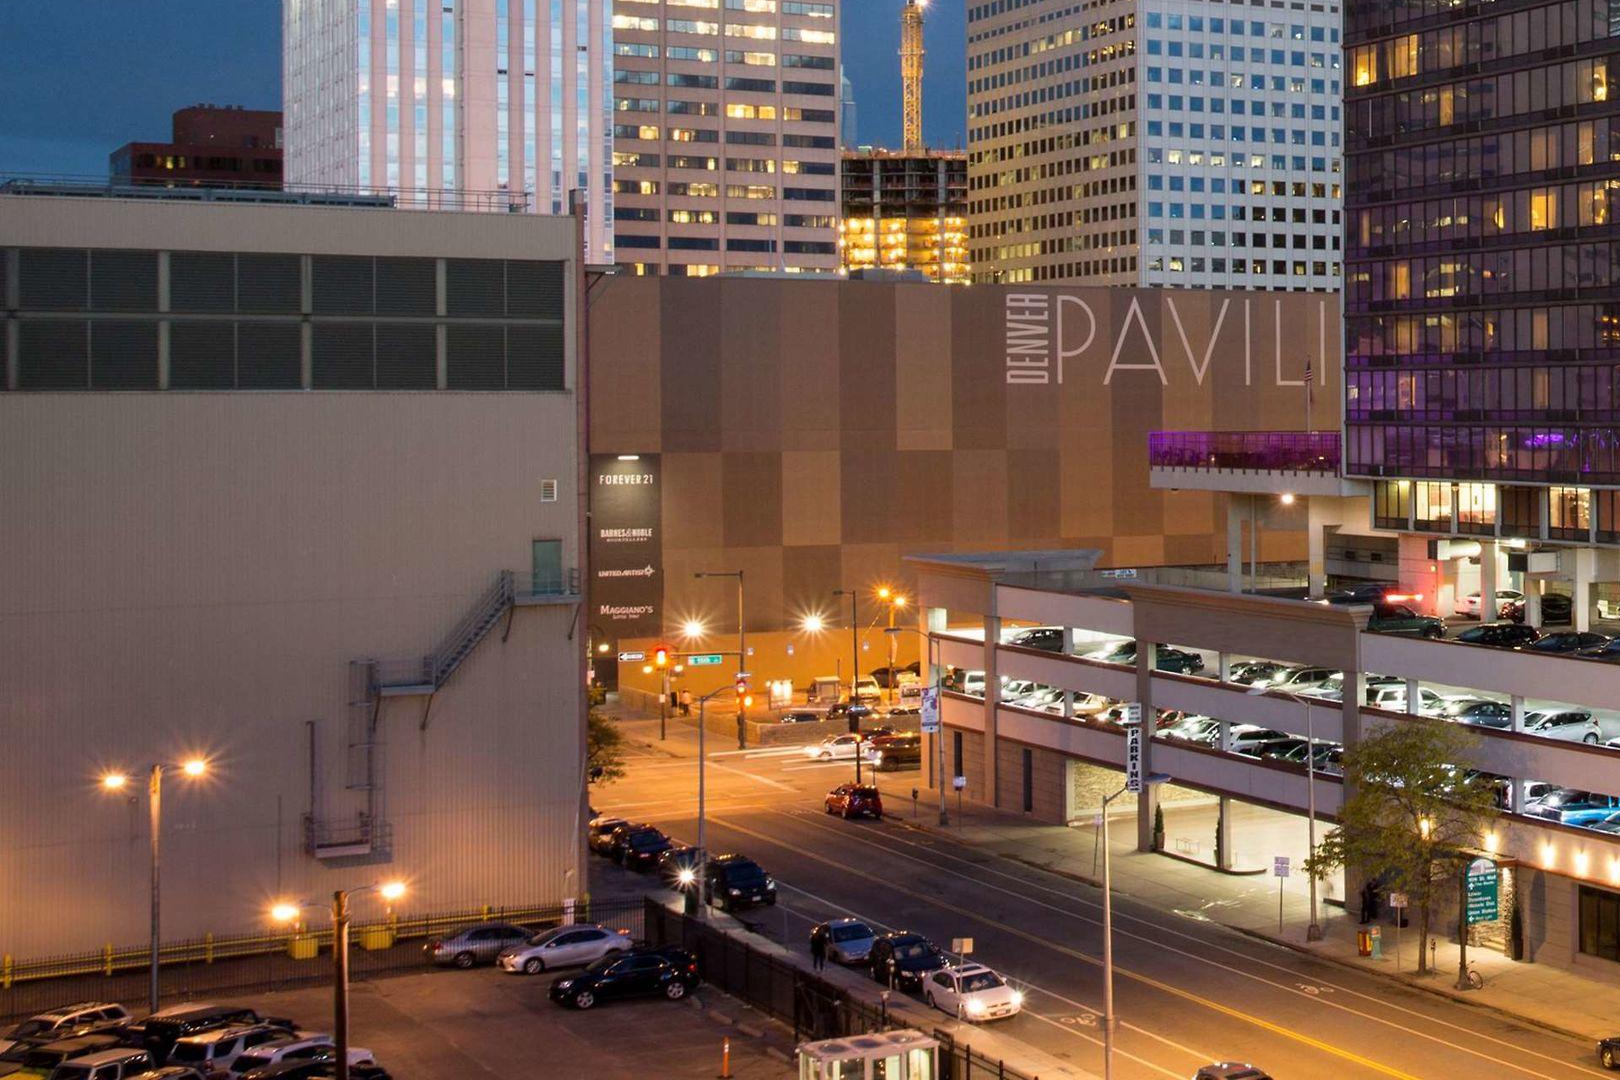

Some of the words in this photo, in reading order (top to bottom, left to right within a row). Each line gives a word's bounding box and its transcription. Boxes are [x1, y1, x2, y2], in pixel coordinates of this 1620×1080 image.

[1006, 293, 1048, 384] DENVER
[599, 473, 641, 486] FOREVER
[642, 473, 654, 486] 21
[1130, 729, 1139, 787] PARKING
